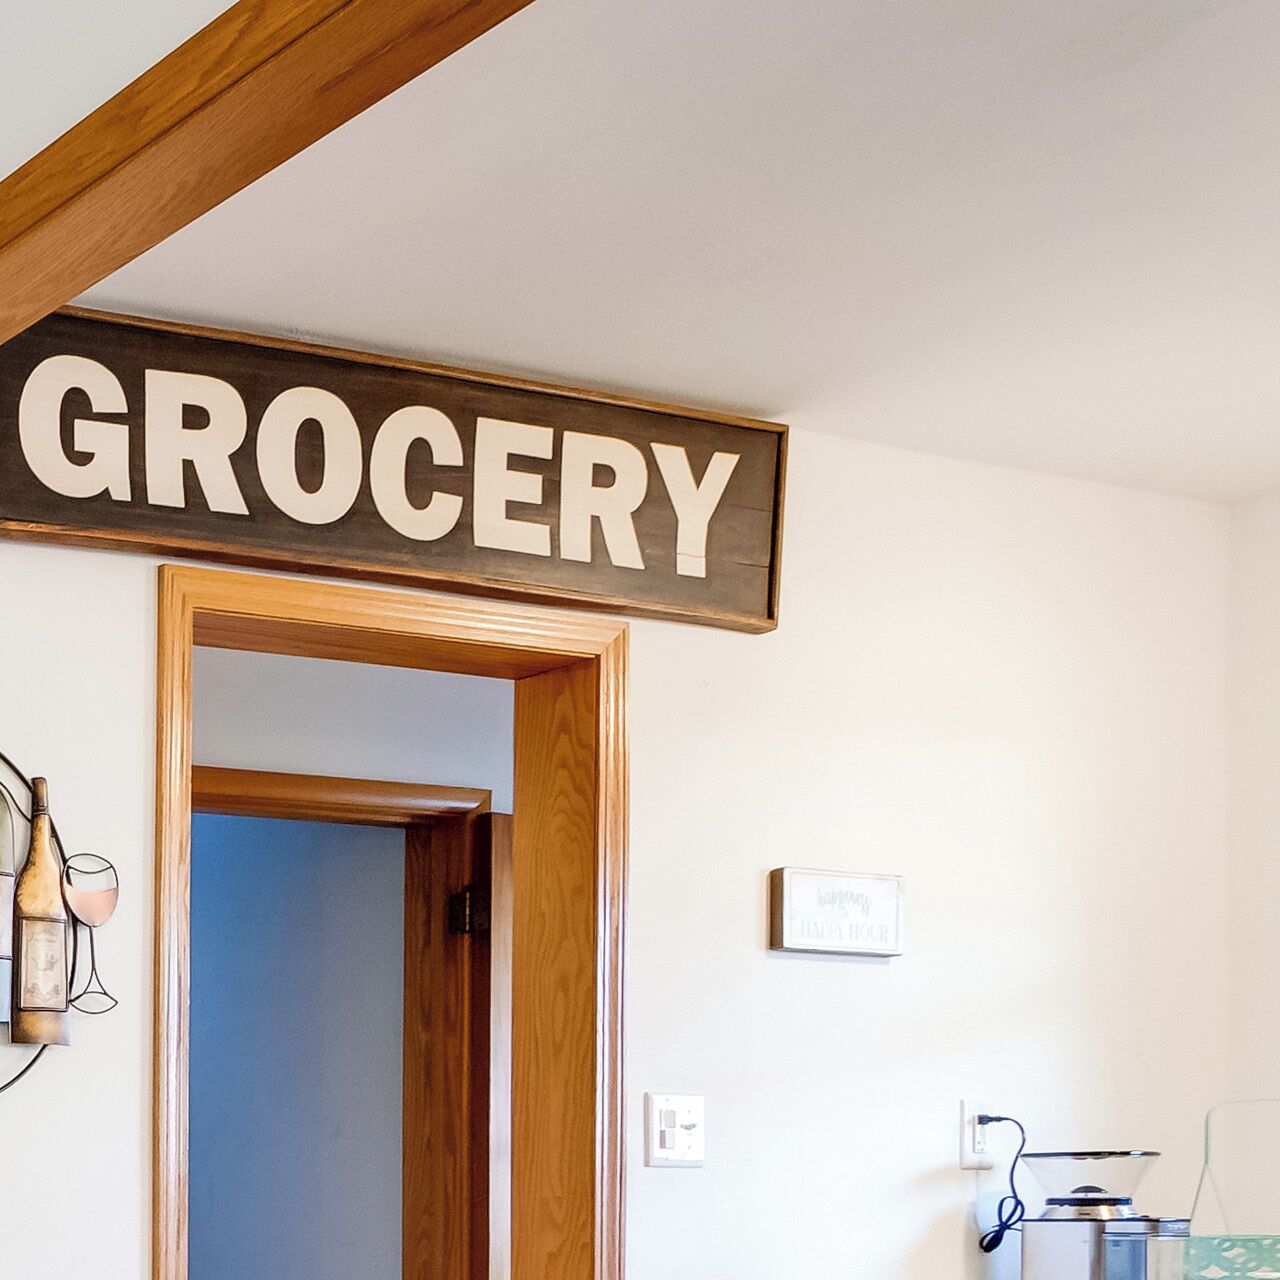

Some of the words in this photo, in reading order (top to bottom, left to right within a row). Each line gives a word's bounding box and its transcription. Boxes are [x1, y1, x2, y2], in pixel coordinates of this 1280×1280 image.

[18, 354, 741, 580] GROCERY
[799, 919, 842, 940] HAPPY
[849, 922, 889, 943] HOUR
